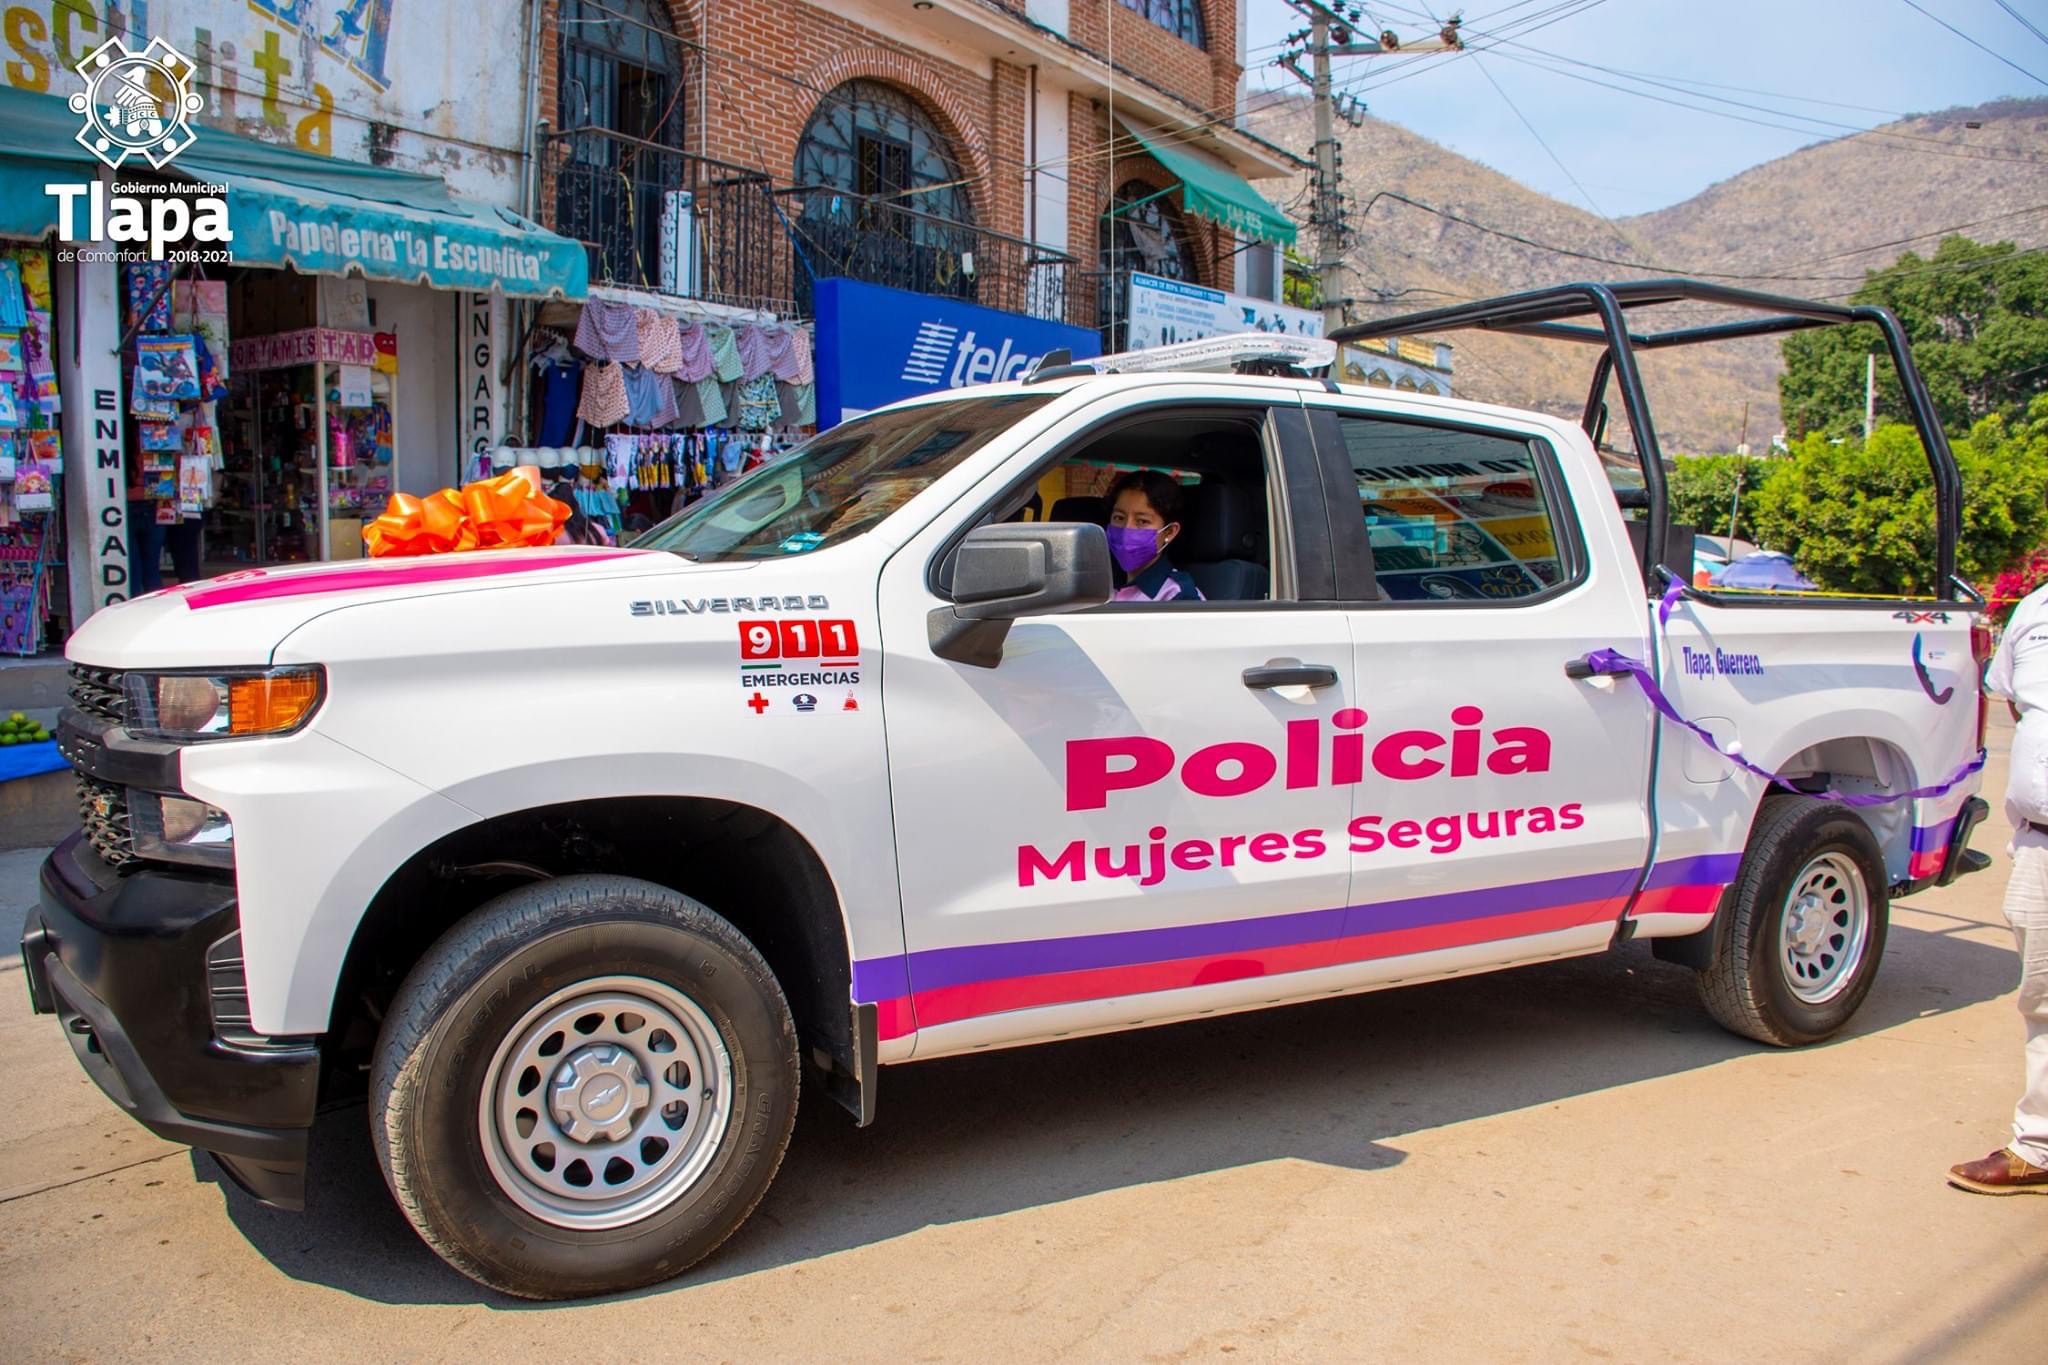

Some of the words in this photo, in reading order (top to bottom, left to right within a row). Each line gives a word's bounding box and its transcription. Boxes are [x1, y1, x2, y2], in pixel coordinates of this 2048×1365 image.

[630, 595, 829, 616] SILVERADO
[748, 624, 847, 655] 911
[742, 672, 860, 687] EMERGENCIAS
[1682, 646, 1715, 681] Tlapa,
[1716, 647, 1764, 675] Guerrero.
[1066, 705, 1552, 812] Policia
[1017, 825, 1326, 887] Mujeres
[1347, 802, 1585, 854] Seguras
